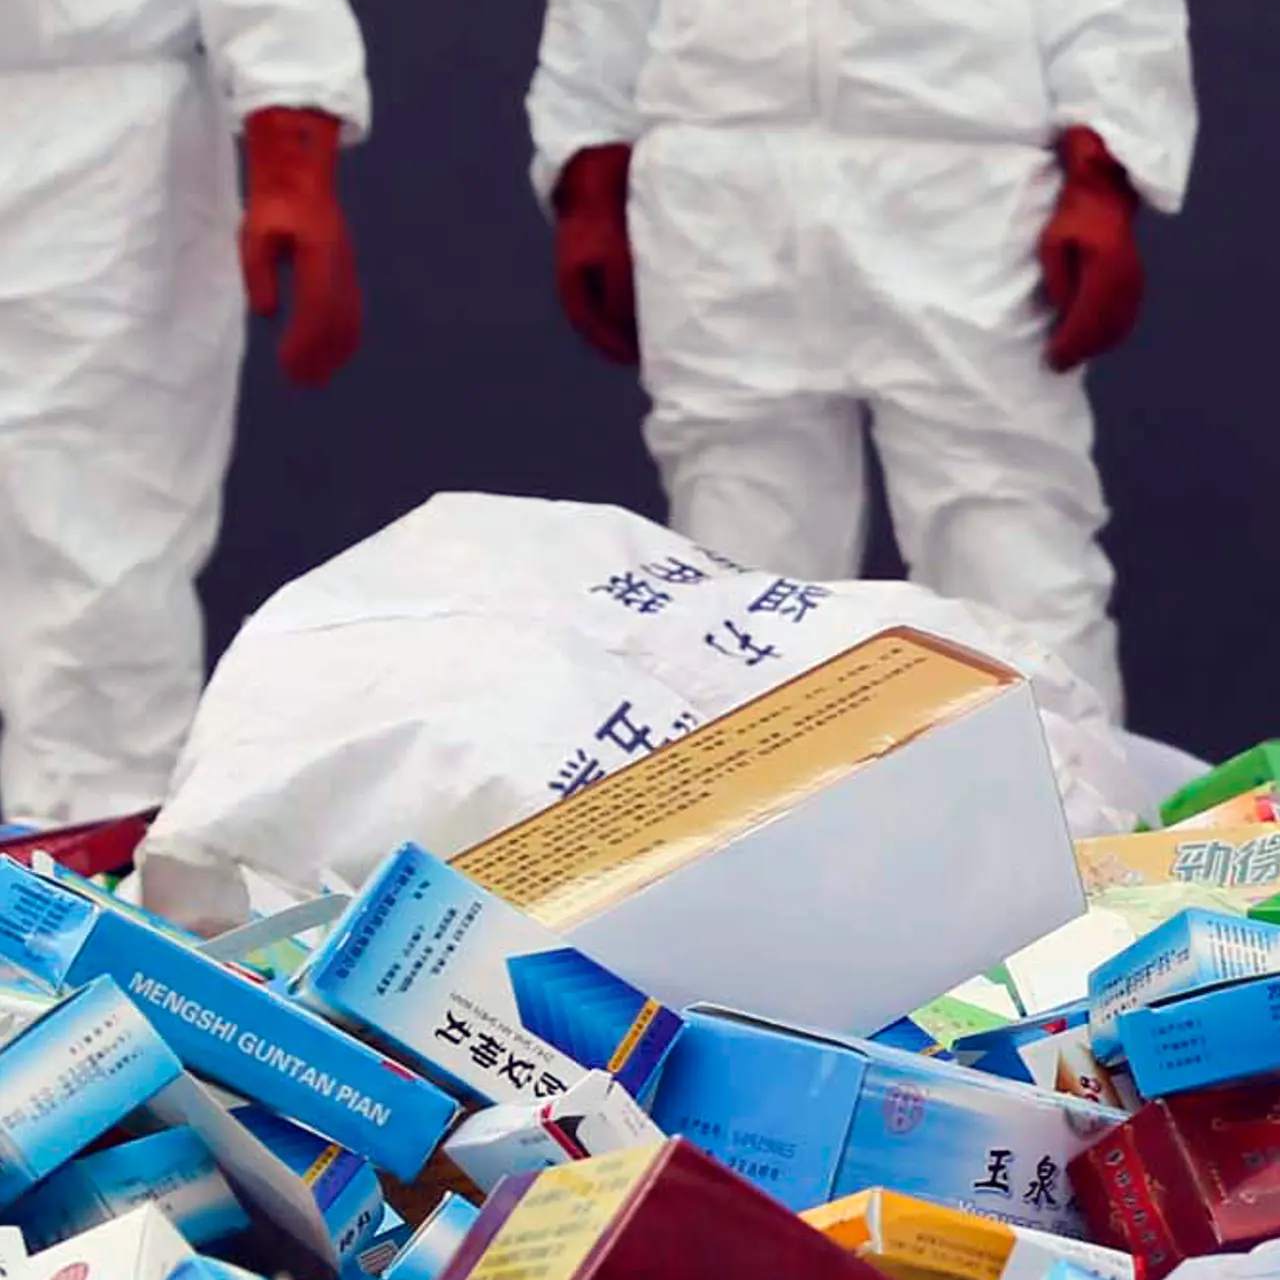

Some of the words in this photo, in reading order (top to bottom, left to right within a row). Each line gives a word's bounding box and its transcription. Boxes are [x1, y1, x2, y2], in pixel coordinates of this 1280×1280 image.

[127, 970, 239, 1045] MENGSHI
[236, 1030, 337, 1098] GUNTAN
[334, 1083, 393, 1128] PIAN
[973, 1149, 1082, 1211] 玉泉
